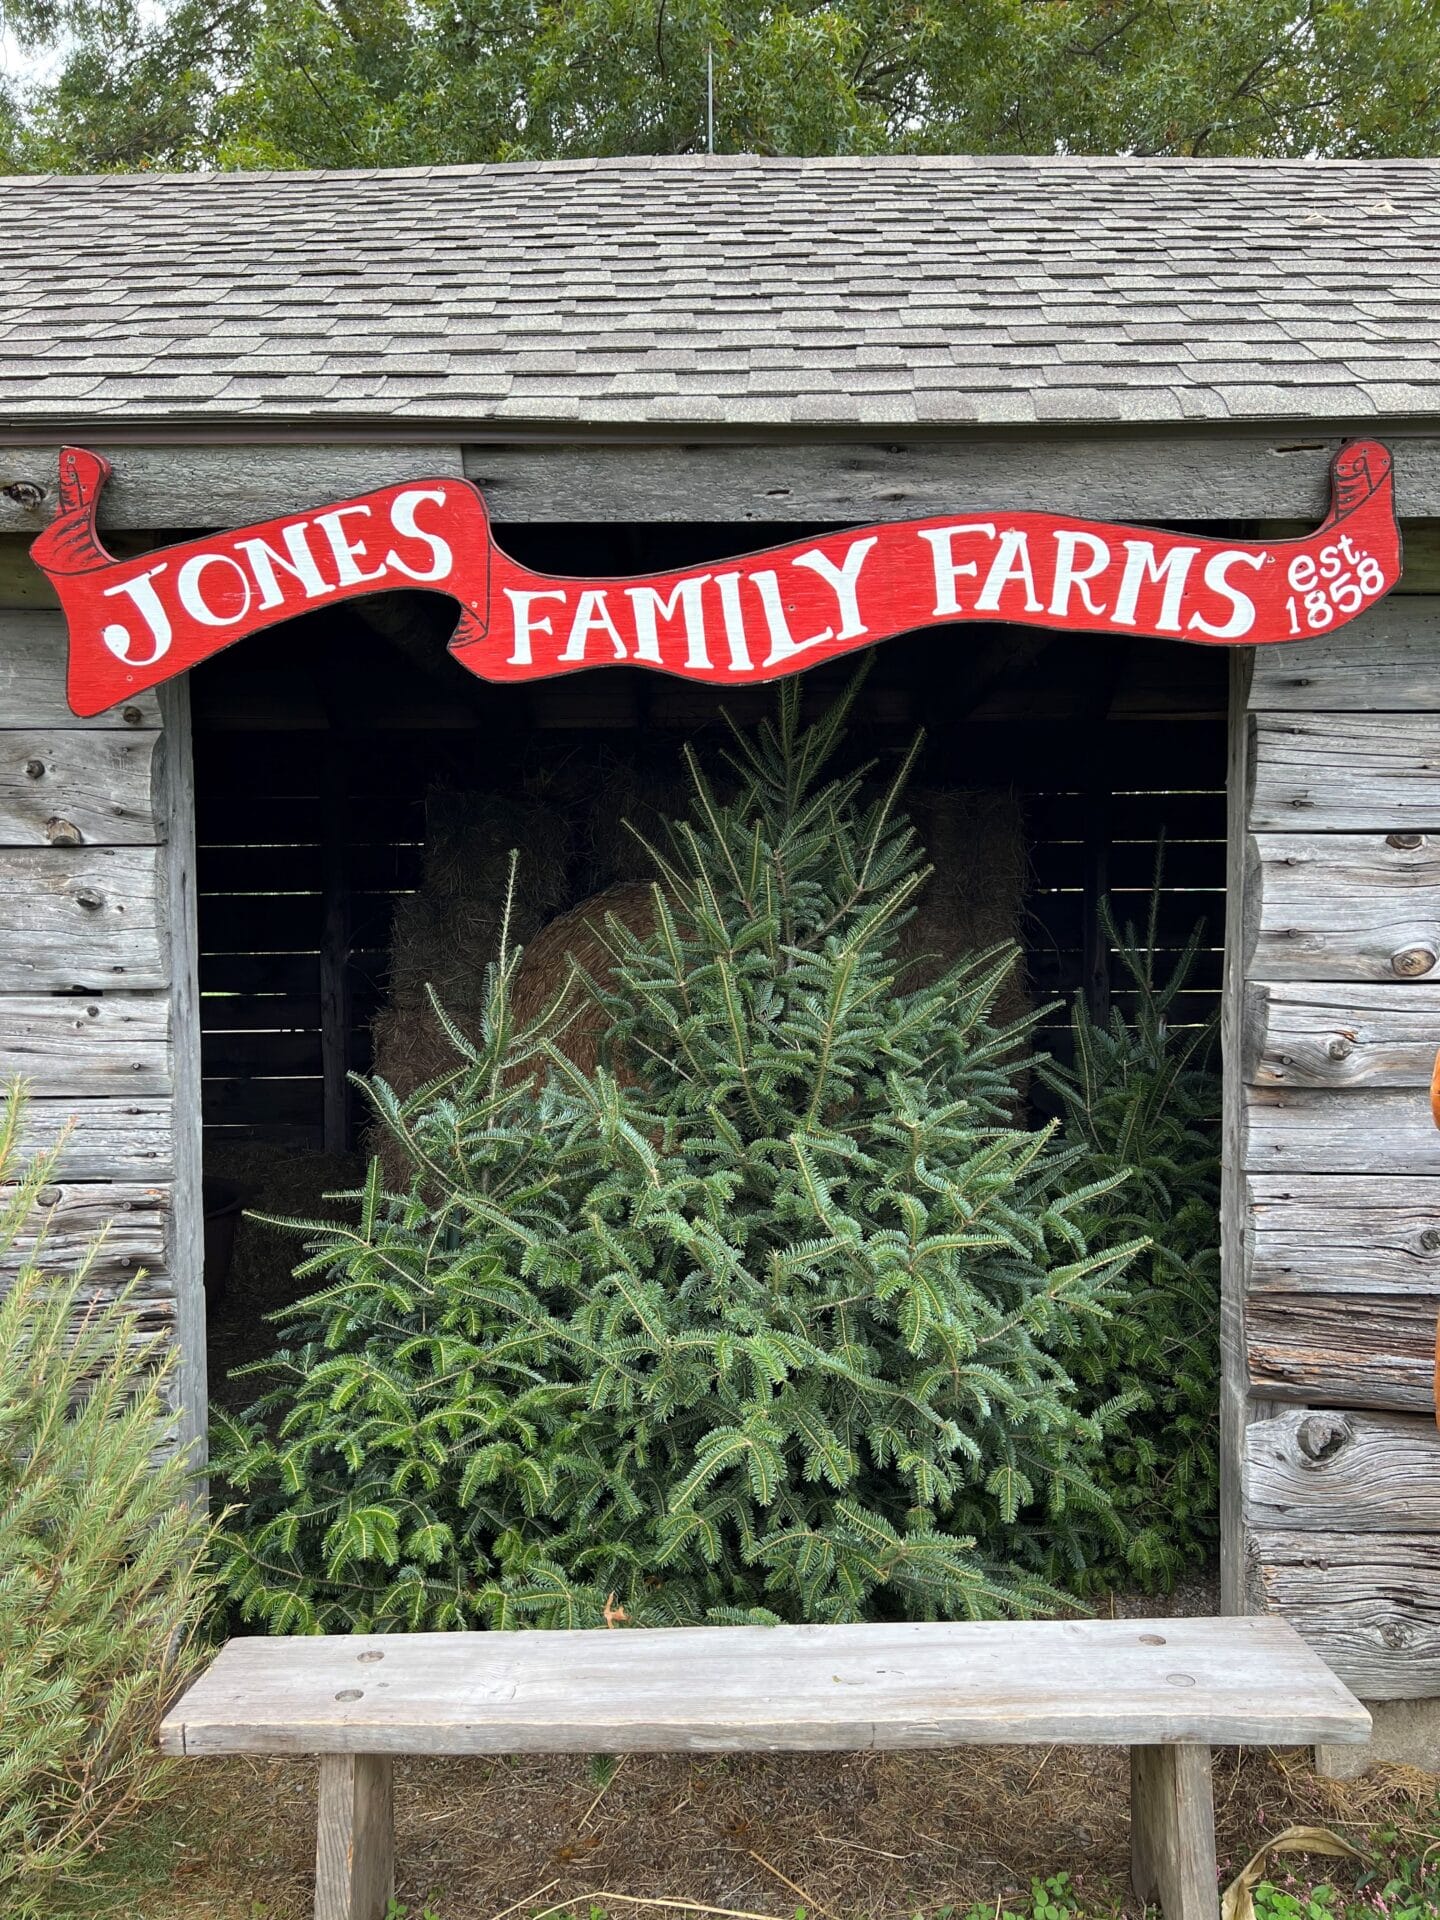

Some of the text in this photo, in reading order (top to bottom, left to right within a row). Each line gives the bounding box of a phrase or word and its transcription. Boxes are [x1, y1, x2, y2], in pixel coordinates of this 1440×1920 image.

[102, 489, 1268, 672] JONES FAMILY FARMS
[1285, 557, 1385, 635] 1858
[1287, 534, 1368, 592] est.
